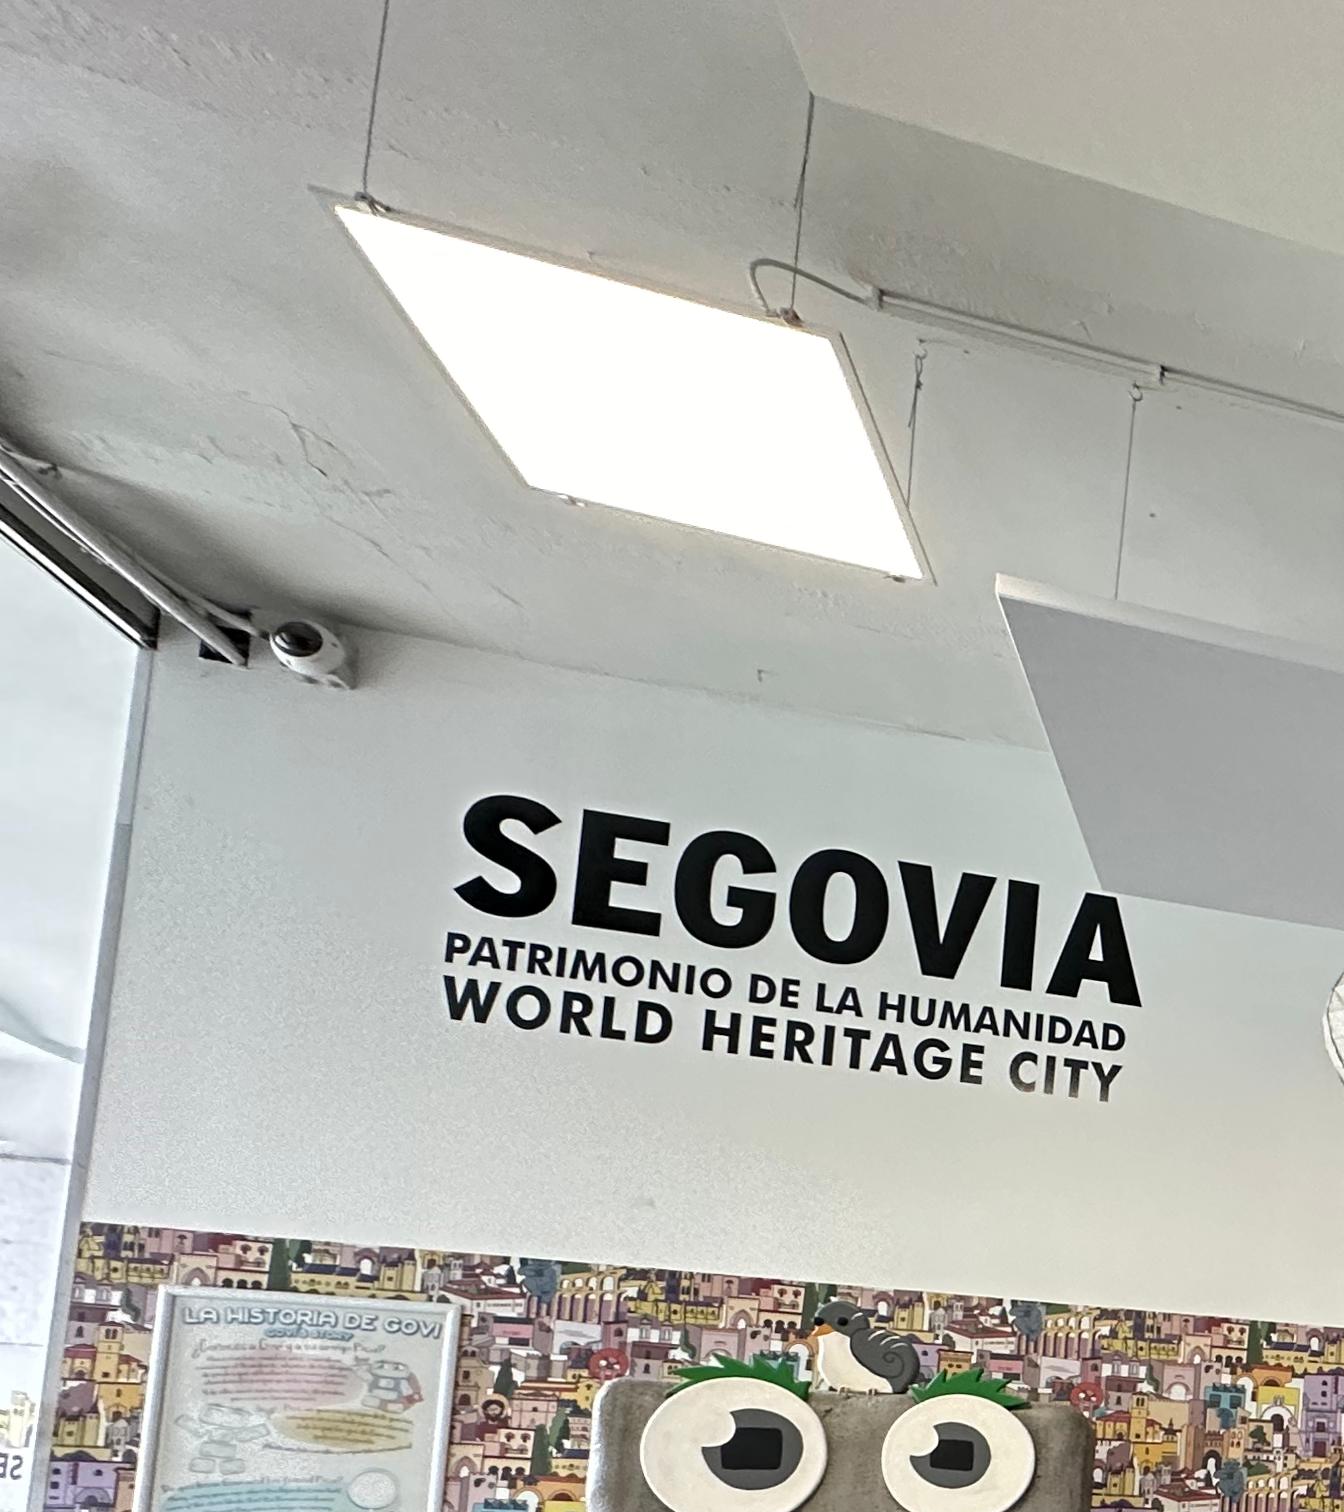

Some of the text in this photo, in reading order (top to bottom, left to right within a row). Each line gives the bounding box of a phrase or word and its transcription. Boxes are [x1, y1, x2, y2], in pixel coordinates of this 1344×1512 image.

[453, 794, 1142, 1007] SEGOVIA
[443, 975, 1123, 1103] WORLD HERITAGE CITY
[444, 932, 1127, 1053] PATRIMONIO DE LA HUMANIDAD
[183, 1305, 443, 1341] LA HISTORIA DE GOVI
